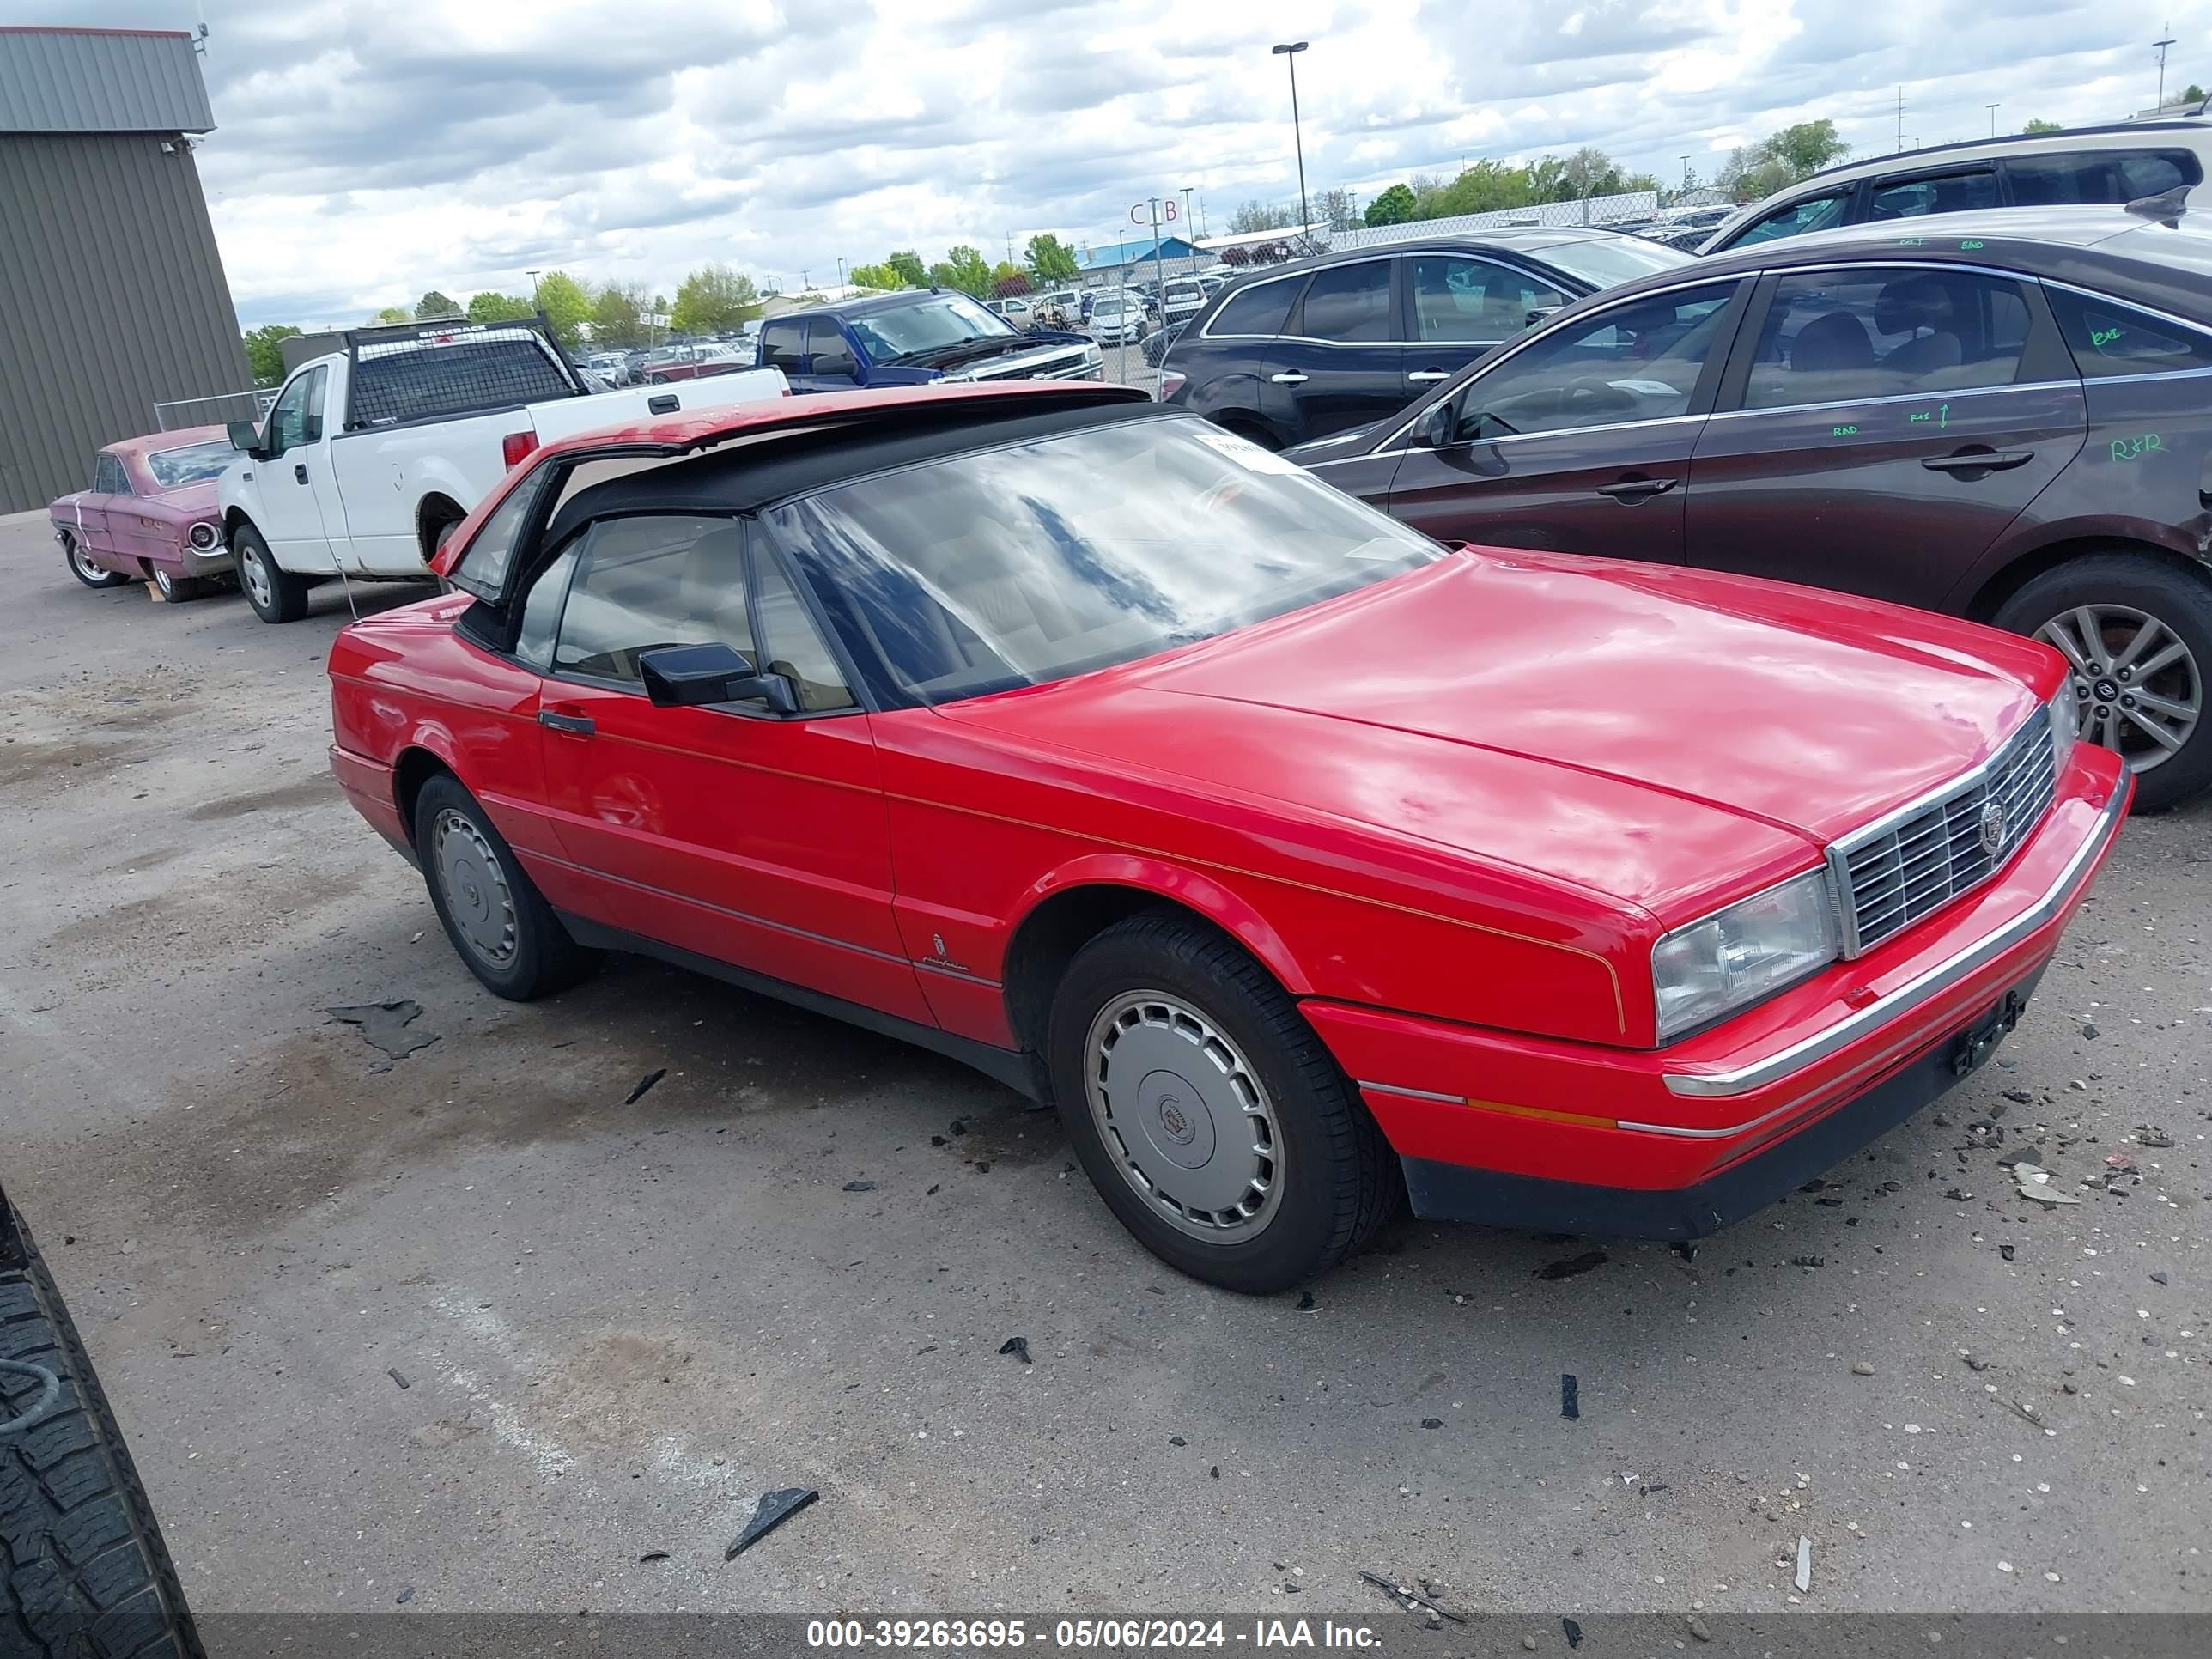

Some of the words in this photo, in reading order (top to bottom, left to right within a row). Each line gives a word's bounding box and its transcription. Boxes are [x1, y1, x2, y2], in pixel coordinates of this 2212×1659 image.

[1131, 204, 1145, 224] C
[1165, 201, 1176, 221] B
[419, 325, 488, 338] BACKRACK
